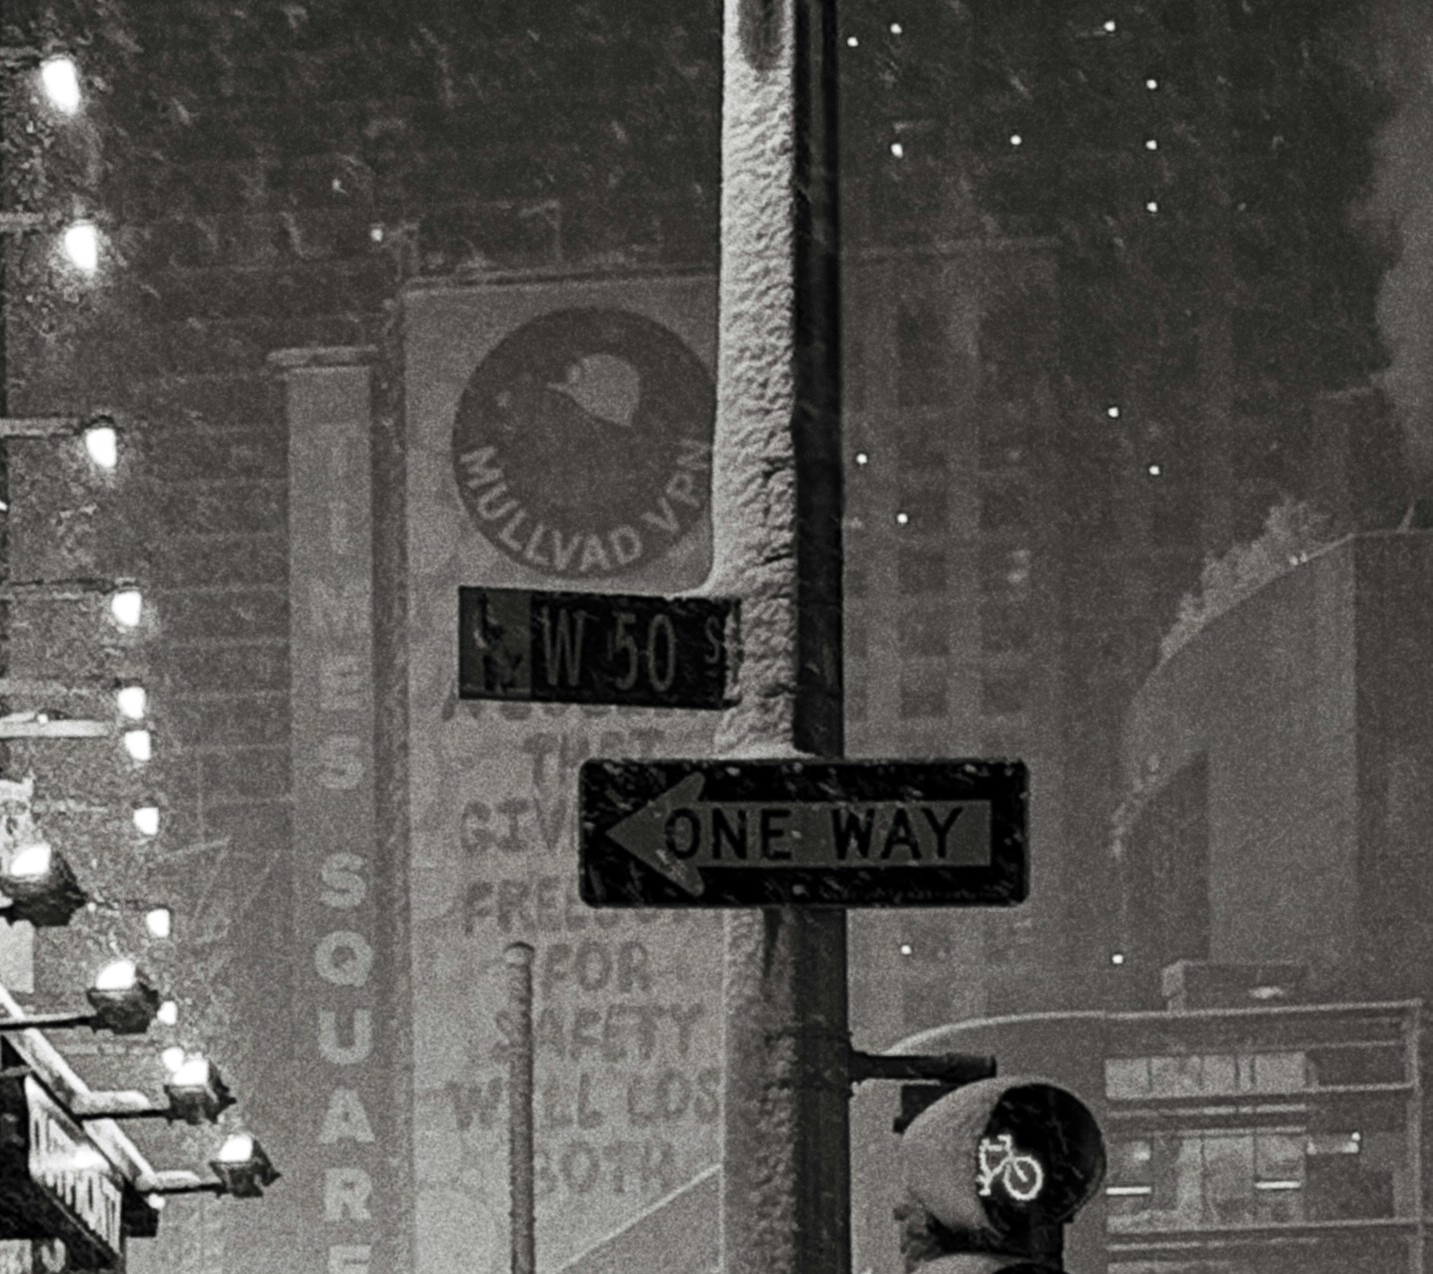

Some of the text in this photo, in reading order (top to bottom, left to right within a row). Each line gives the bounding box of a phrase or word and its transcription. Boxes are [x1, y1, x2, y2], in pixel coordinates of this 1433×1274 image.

[459, 435, 710, 573] MULLVAD VPN
[542, 606, 586, 687] W
[612, 610, 677, 692] 50
[668, 807, 964, 861] ONE WAY
[540, 940, 651, 996] FOR
[445, 1065, 722, 1132] WLL LOS
